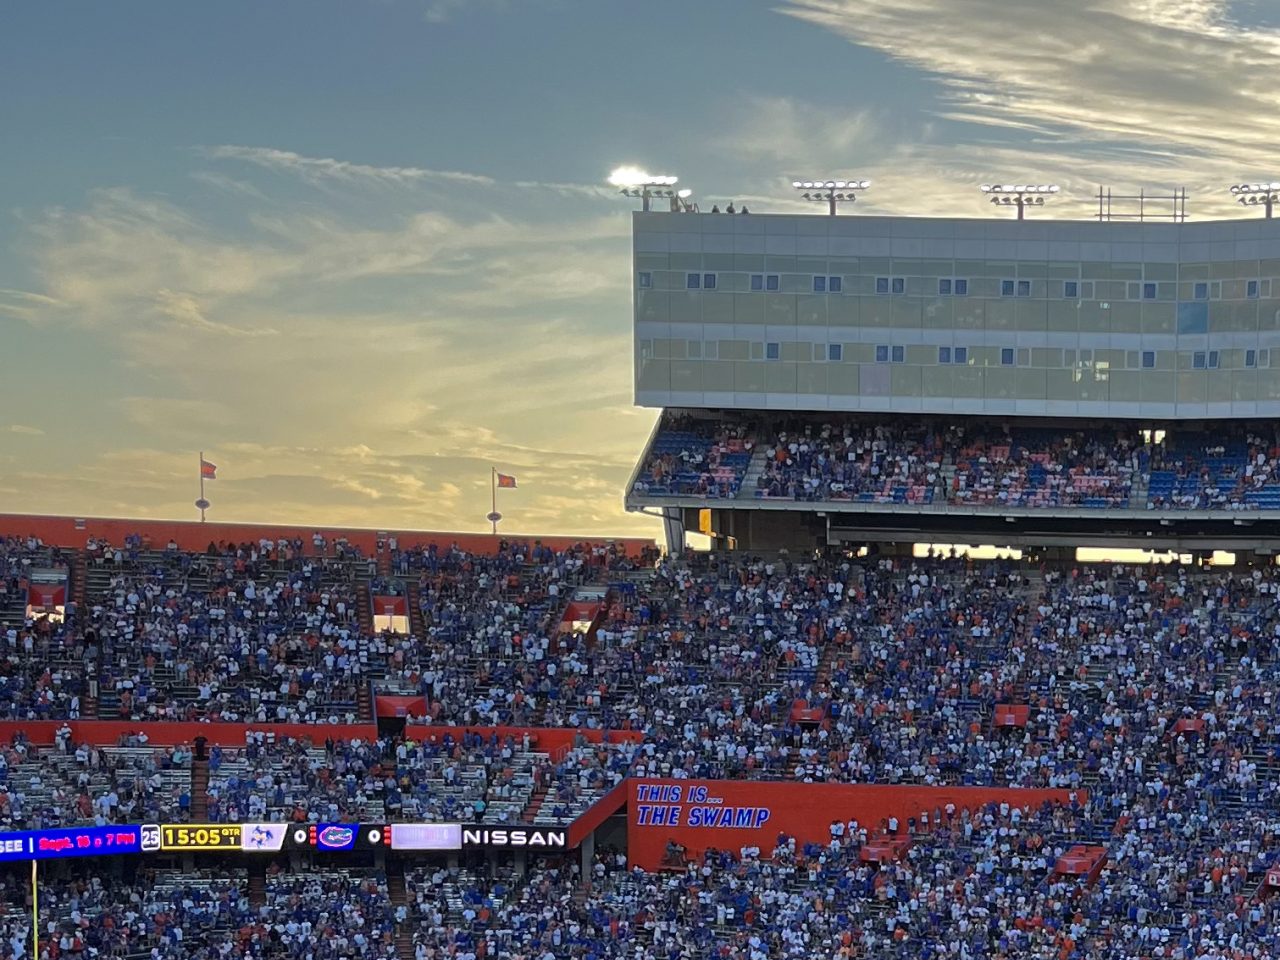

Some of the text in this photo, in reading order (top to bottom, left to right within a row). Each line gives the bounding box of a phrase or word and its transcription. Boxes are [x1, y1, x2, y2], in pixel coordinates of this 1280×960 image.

[637, 784, 724, 804] THIS IS...
[637, 805, 770, 828] THE SWAMP
[142, 831, 160, 845] 25
[165, 829, 220, 845] 15:05
[221, 828, 240, 836] QTR
[294, 829, 306, 843] 0
[368, 829, 380, 843] 0
[463, 829, 565, 846] NISSAN
